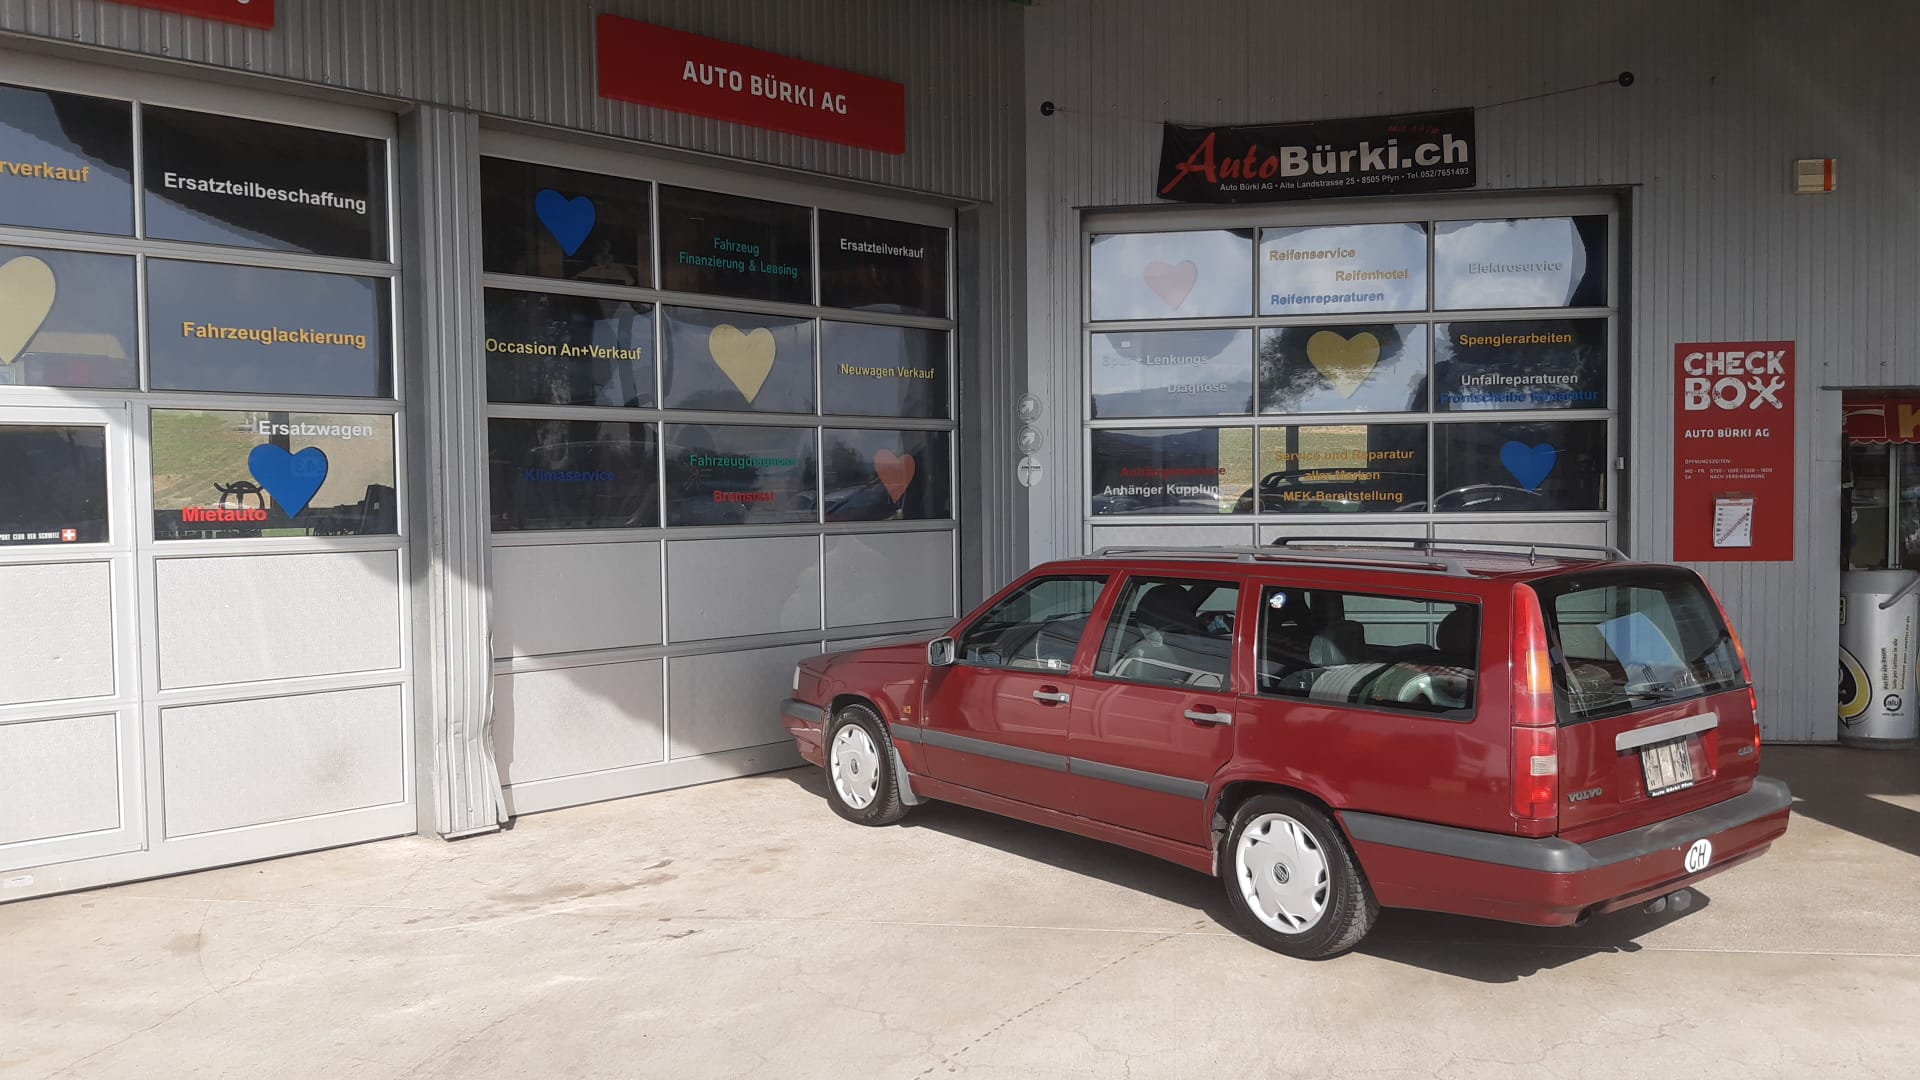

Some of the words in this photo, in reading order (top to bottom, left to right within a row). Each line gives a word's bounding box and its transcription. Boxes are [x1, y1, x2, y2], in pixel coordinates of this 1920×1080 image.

[683, 60, 743, 92] AUTO
[751, 74, 814, 107] BÜRKI
[821, 91, 847, 115] AG
[1220, 183, 1237, 191] Auto
[1240, 182, 1259, 191] Bürki
[1261, 182, 1273, 190] AG
[1280, 181, 1295, 189] Alte
[1296, 177, 1344, 189] Landstrasse
[1345, 177, 1355, 185] 25
[1361, 175, 1380, 184] 8505
[1381, 174, 1399, 183] Pfyn
[164, 172, 367, 215] Ersatzteilbeschaffung
[714, 237, 759, 257] Fahrzeug
[840, 238, 924, 260] Ersatzteilverkauf
[1269, 247, 1356, 261] Reifenservice
[679, 251, 745, 273] Finanzierung
[749, 259, 756, 272] &
[760, 260, 798, 279] Leasing
[1468, 259, 1563, 275] Elektroservice
[1335, 268, 1408, 282] Reifenhotel
[1270, 290, 1384, 305] Reifenreparaturen
[183, 321, 366, 349] Fahrzeuglackierung
[1459, 333, 1572, 347] Spenglerarbeiten
[485, 338, 557, 357] Occasion
[560, 343, 642, 361] An+Verkauf
[1146, 354, 1209, 367] Lenkungs
[1683, 350, 1786, 376] CHECK
[840, 363, 895, 378] Neuwagen
[897, 366, 935, 380] Verkauf
[1461, 373, 1578, 387] Unfallreparaturen
[1167, 382, 1227, 395] Diagnose
[1684, 375, 1785, 411] BOX
[259, 421, 373, 440] Ersatzwagen
[1685, 429, 1714, 438] AUTO
[1717, 427, 1752, 438] BÜRKI
[1755, 428, 1770, 437] AG
[1275, 450, 1321, 461] Service
[1324, 449, 1347, 460] und
[1352, 449, 1415, 461] Reparatur
[525, 470, 616, 481] Klimaservice
[1103, 484, 1164, 497] Anhänger
[182, 506, 268, 523] Mietauto
[1567, 787, 1603, 803] VOLVO
[1689, 843, 1706, 870] CH
